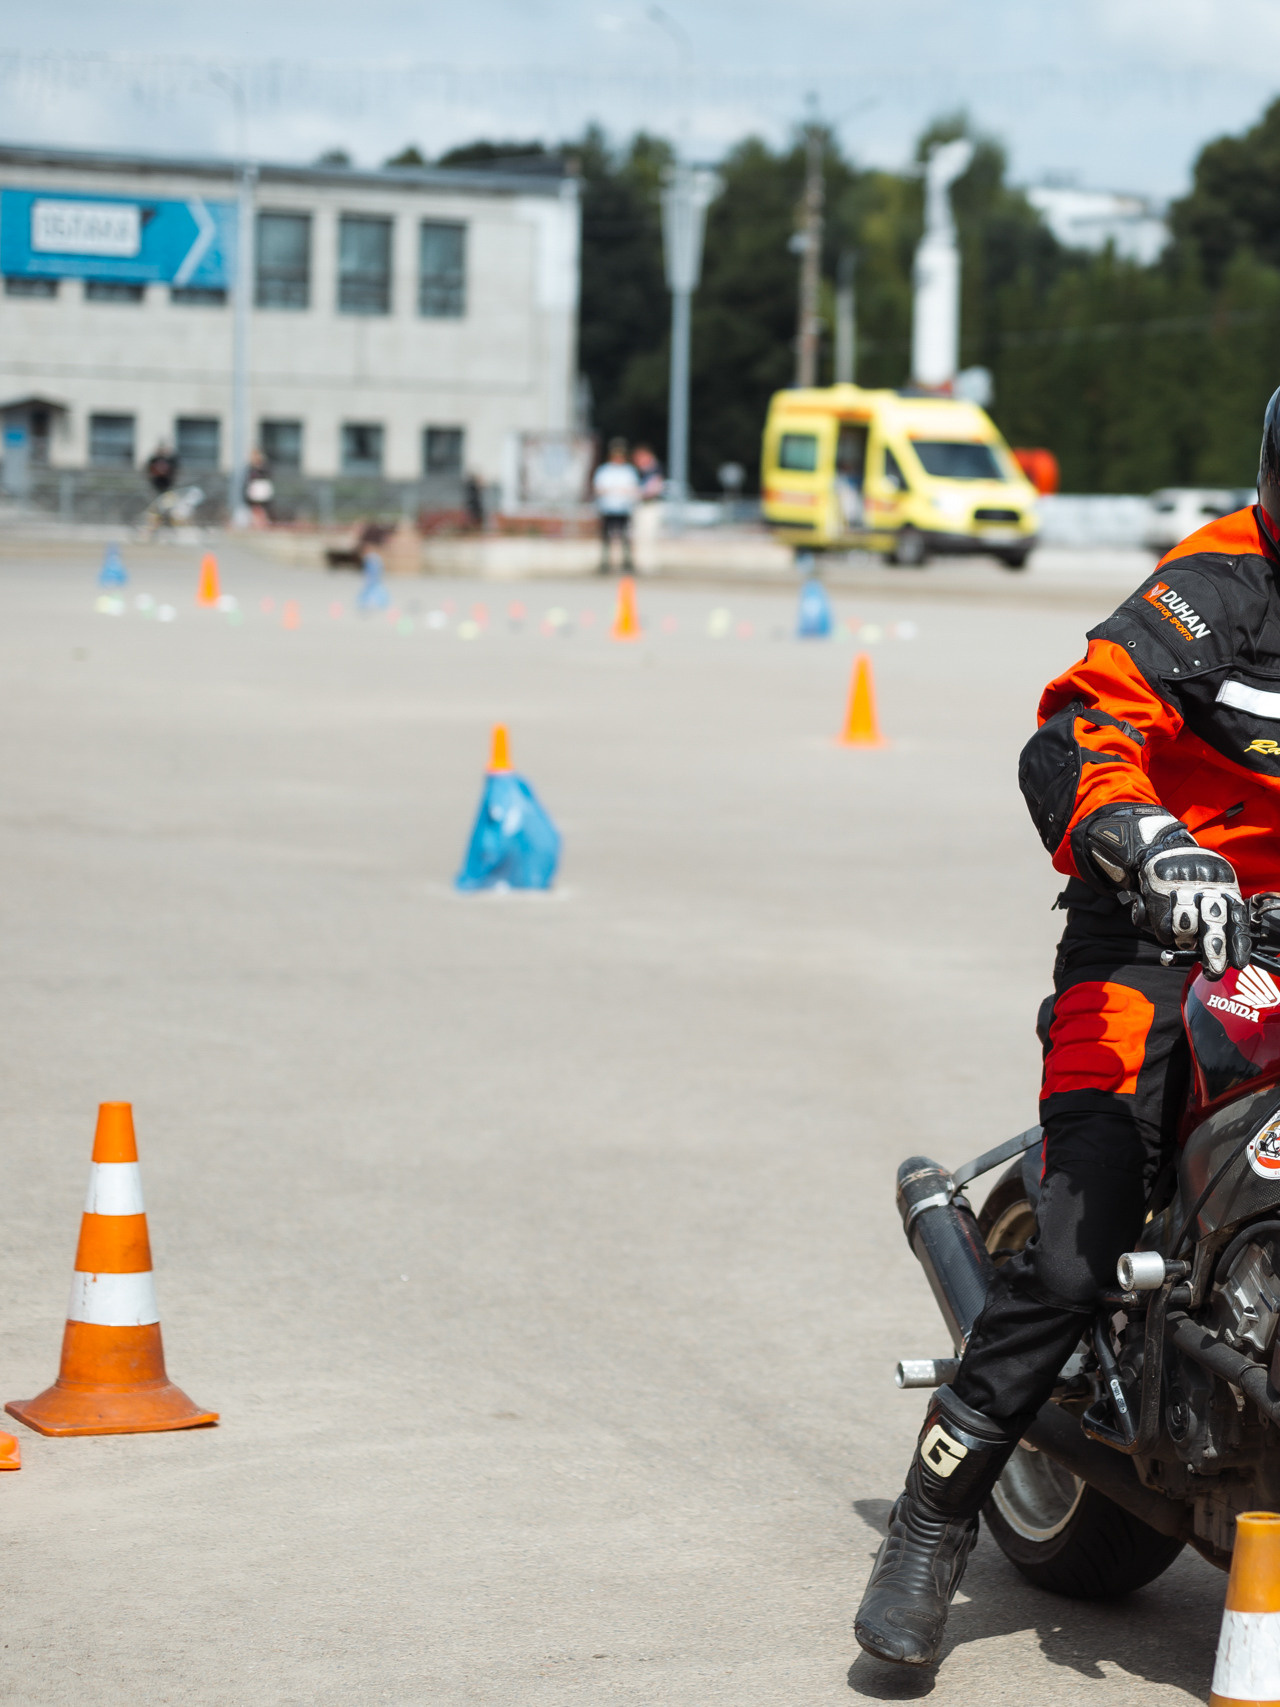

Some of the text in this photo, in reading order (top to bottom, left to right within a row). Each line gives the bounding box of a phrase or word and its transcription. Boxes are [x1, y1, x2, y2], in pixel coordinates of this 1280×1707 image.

[1150, 600, 1194, 642] MOTOR SPORTS
[1160, 590, 1212, 639] DUHAN
[1207, 994, 1260, 1023] HONDA
